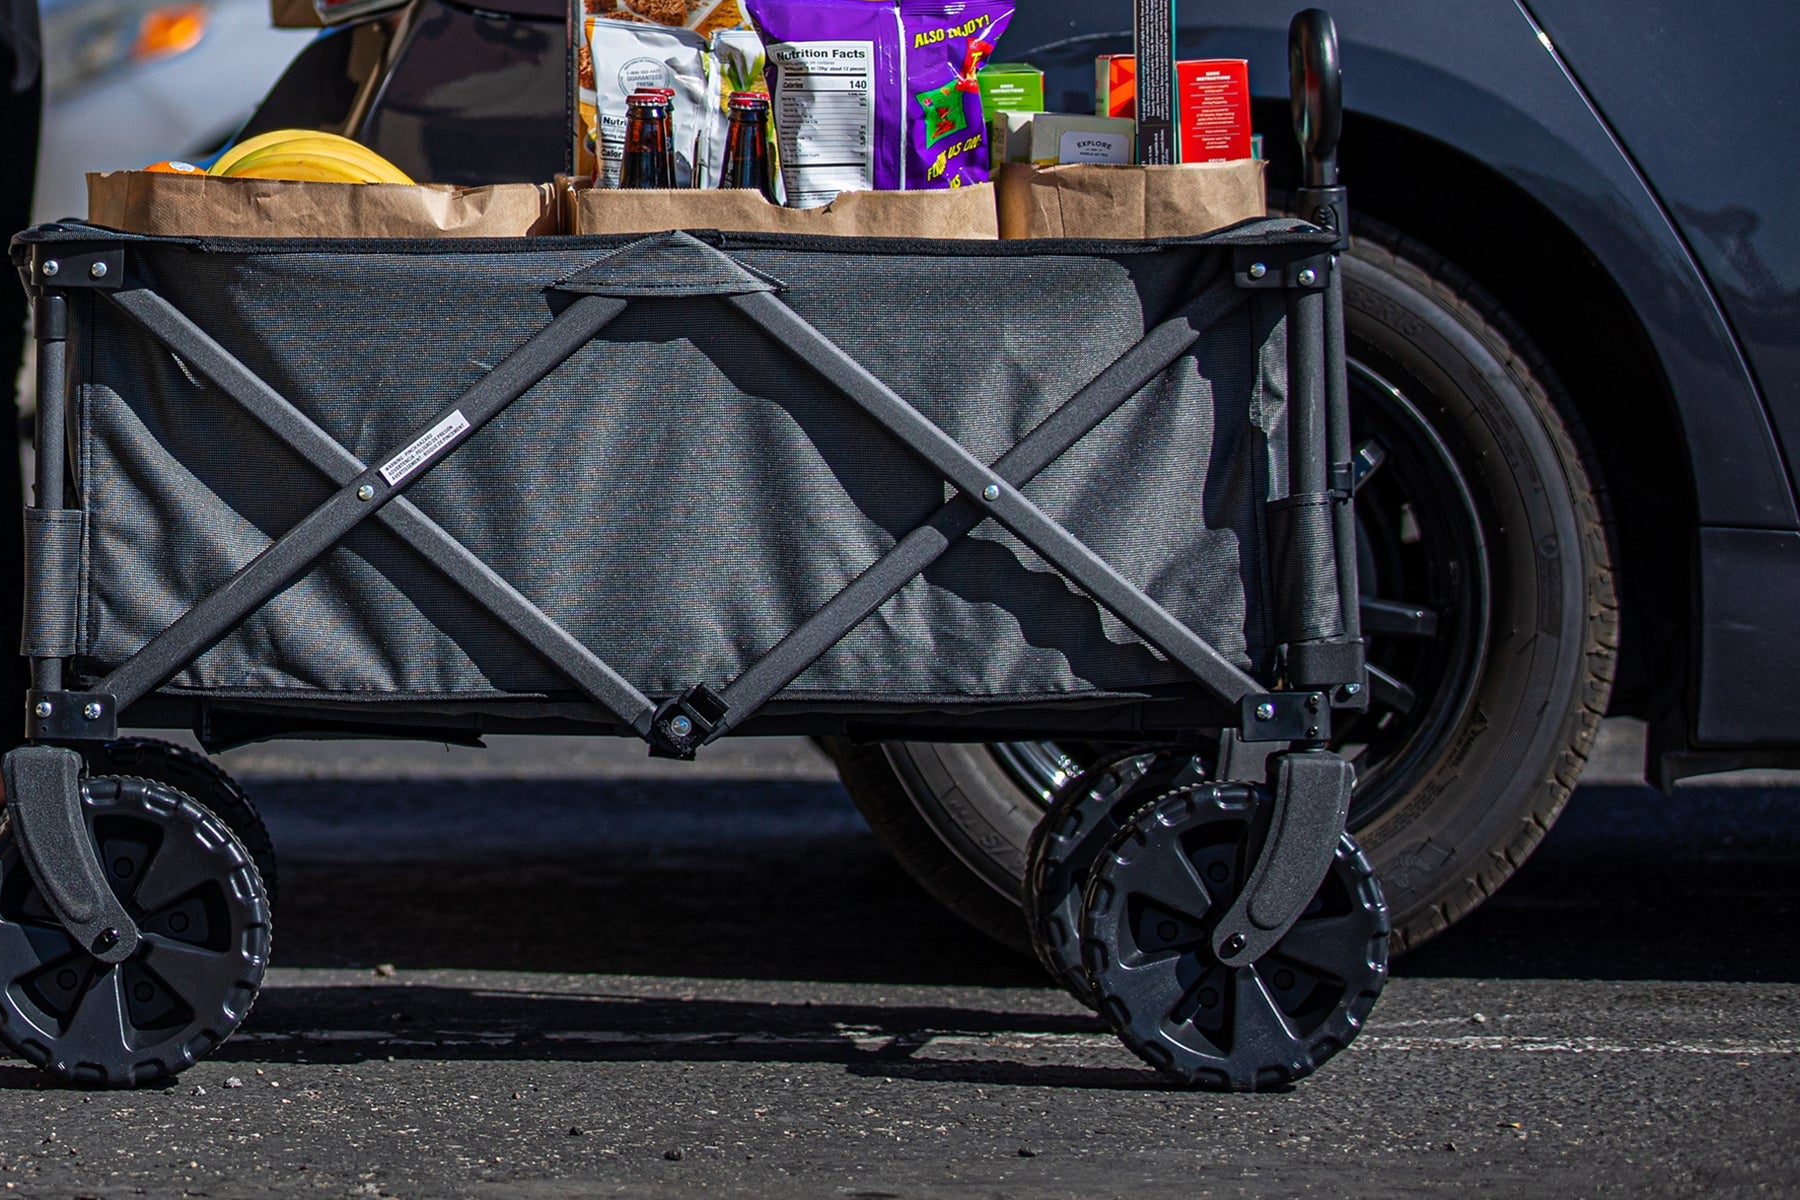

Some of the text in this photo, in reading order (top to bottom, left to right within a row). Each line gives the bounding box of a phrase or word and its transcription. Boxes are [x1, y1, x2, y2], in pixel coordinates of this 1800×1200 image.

[914, 14, 990, 48] ALSO ENJOY!
[777, 49, 865, 60] Nutrition Facts
[850, 81, 867, 89] 140
[603, 117, 626, 126] Nutri
[948, 142, 962, 159] US
[1077, 140, 1112, 150] EXPLORE
[601, 149, 622, 158] Calor
[385, 456, 403, 471] WARNING
[417, 433, 432, 446] HAZARD
[388, 455, 414, 475] ADVERTENCIA
